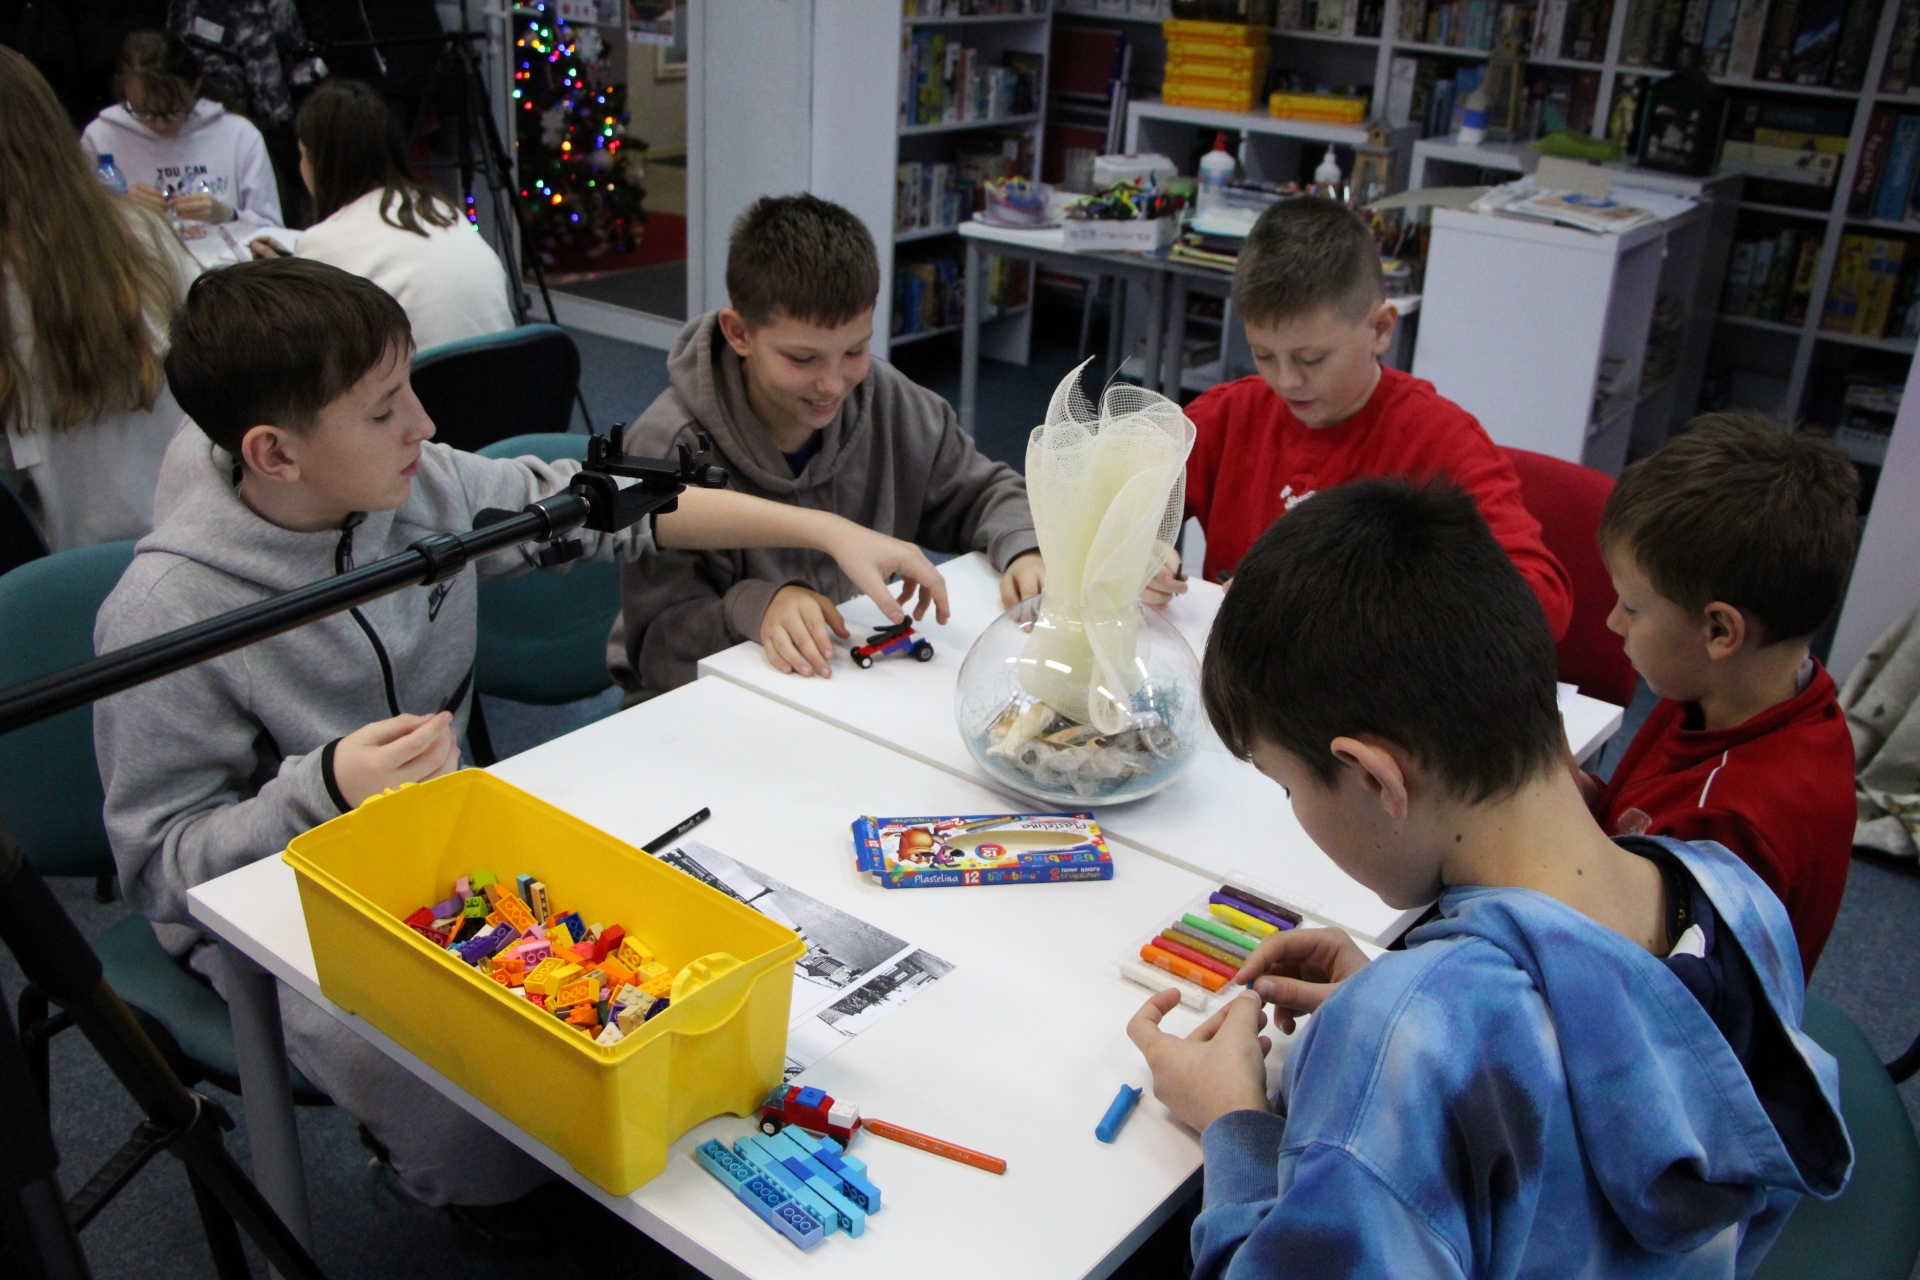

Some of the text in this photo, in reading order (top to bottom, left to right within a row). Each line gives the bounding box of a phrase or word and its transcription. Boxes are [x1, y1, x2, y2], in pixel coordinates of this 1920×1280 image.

[156, 165, 207, 178] YOU CAN
[1021, 822, 1087, 830] Plastelina
[1024, 853, 1095, 863] bambino
[914, 873, 959, 884] Plastelina
[965, 871, 980, 884] 12
[987, 870, 1036, 882] bambino
[1050, 867, 1060, 881] 2
